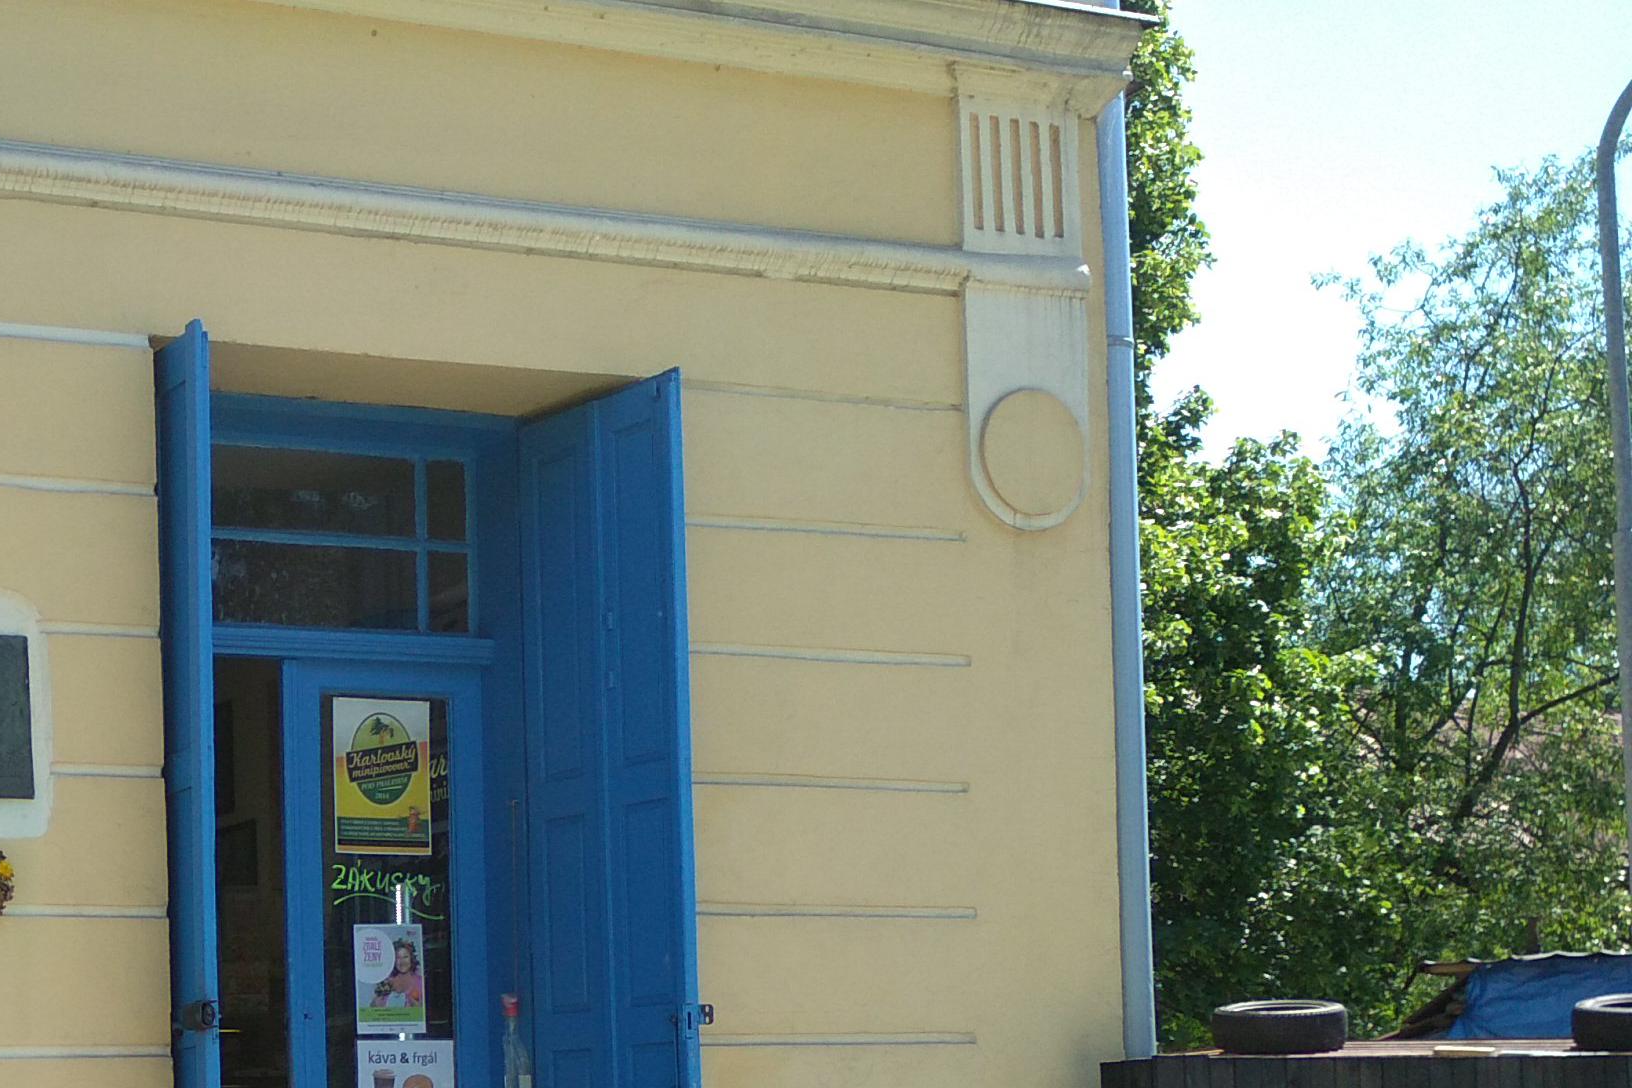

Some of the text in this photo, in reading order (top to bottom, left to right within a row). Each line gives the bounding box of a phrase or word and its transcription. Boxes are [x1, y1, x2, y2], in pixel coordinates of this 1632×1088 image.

[368, 1050, 438, 1067] káva & frgál
